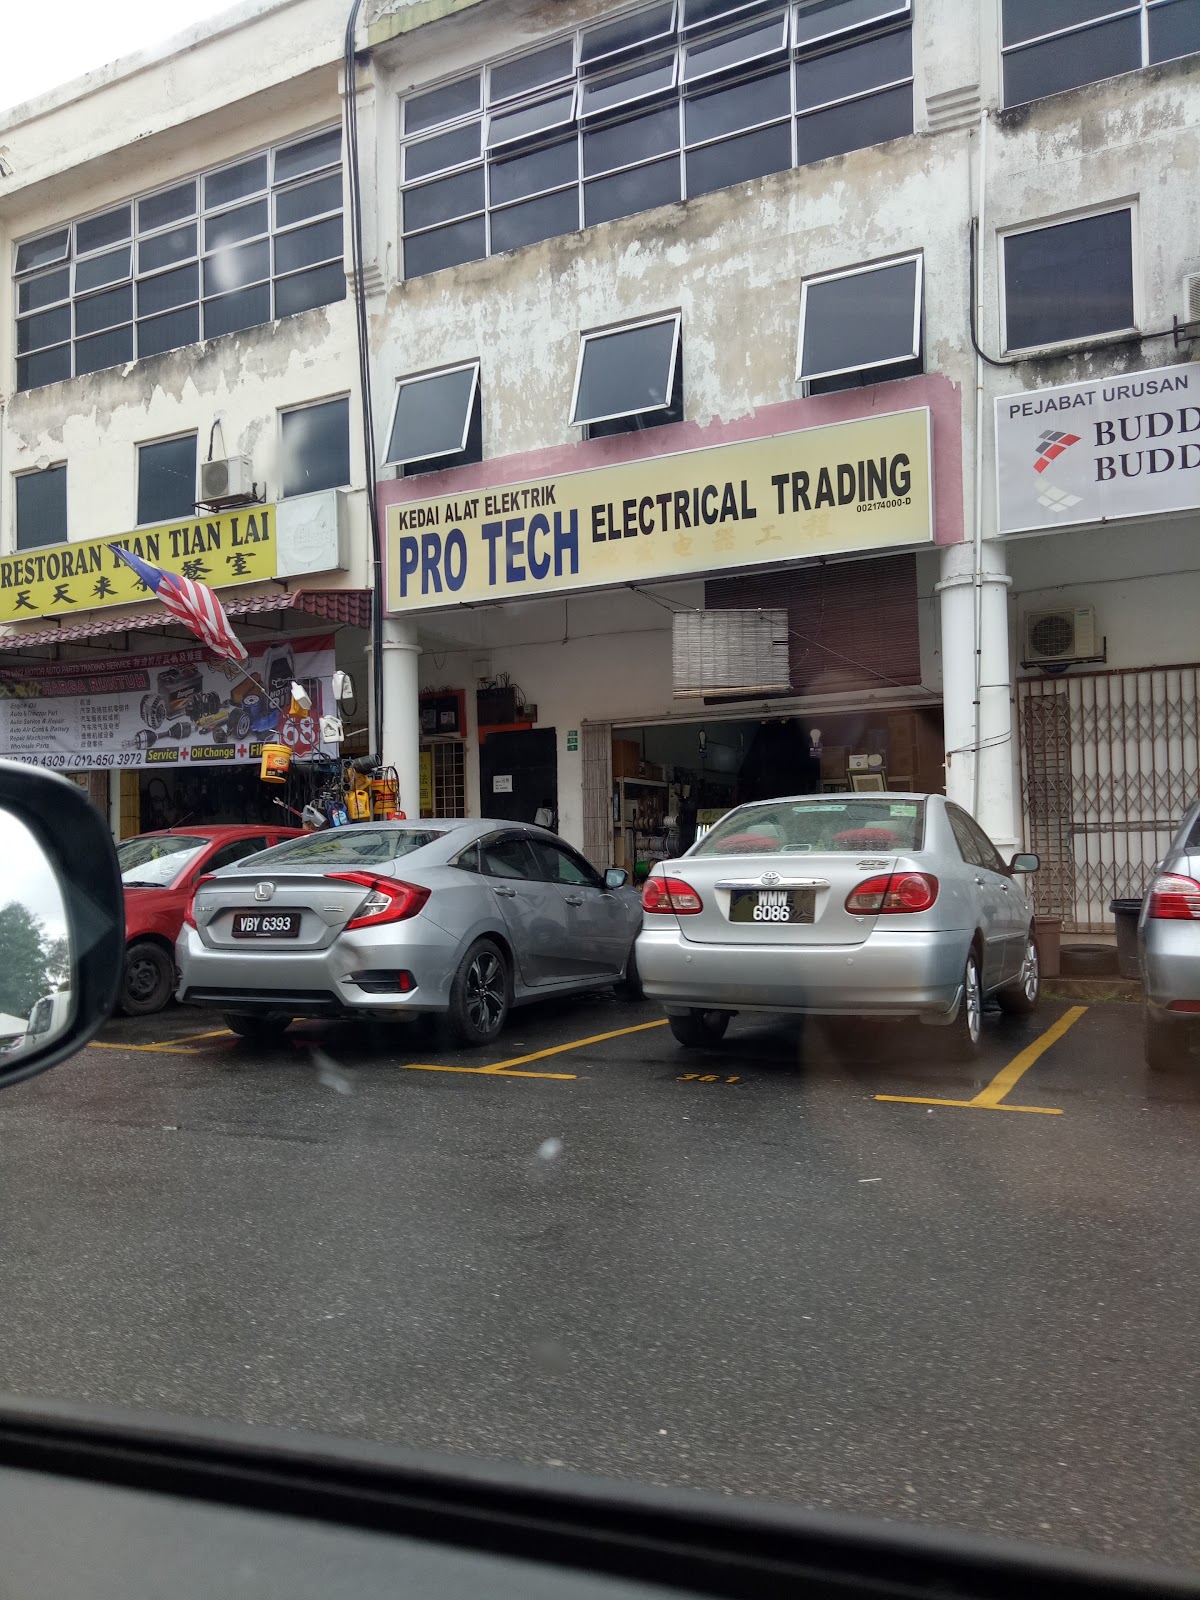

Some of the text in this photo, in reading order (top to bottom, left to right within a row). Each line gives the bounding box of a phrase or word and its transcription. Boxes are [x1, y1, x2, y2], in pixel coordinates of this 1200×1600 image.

[1009, 375, 1188, 419] PEJABAT URUSAN
[1093, 406, 1200, 447] BUDD
[1093, 443, 1200, 483] BUDD
[399, 484, 556, 531] KEDAI ALAT ELEKTRIK
[591, 453, 912, 543] ELECTRICAL TRADING
[856, 496, 912, 513] 002174000-D
[0, 544, 103, 588] RESTORAN
[168, 521, 221, 558] TIAN
[230, 511, 270, 547] LAI
[399, 508, 579, 598] PRO TECH
[46, 666, 61, 675] AUTO
[61, 665, 80, 674] PARTS
[80, 662, 106, 672] TRADING
[106, 660, 131, 670] SERVICE
[42, 674, 147, 696] HARGA RUNTUH
[40, 755, 66, 767] 4309
[74, 754, 115, 767] 012-650
[118, 752, 143, 765] 3972
[147, 748, 178, 761] Service
[191, 747, 203, 758] Oil
[205, 746, 235, 759] Change
[757, 891, 788, 906] WMW
[240, 916, 292, 932] VBY 6393
[752, 905, 790, 922] 6086
